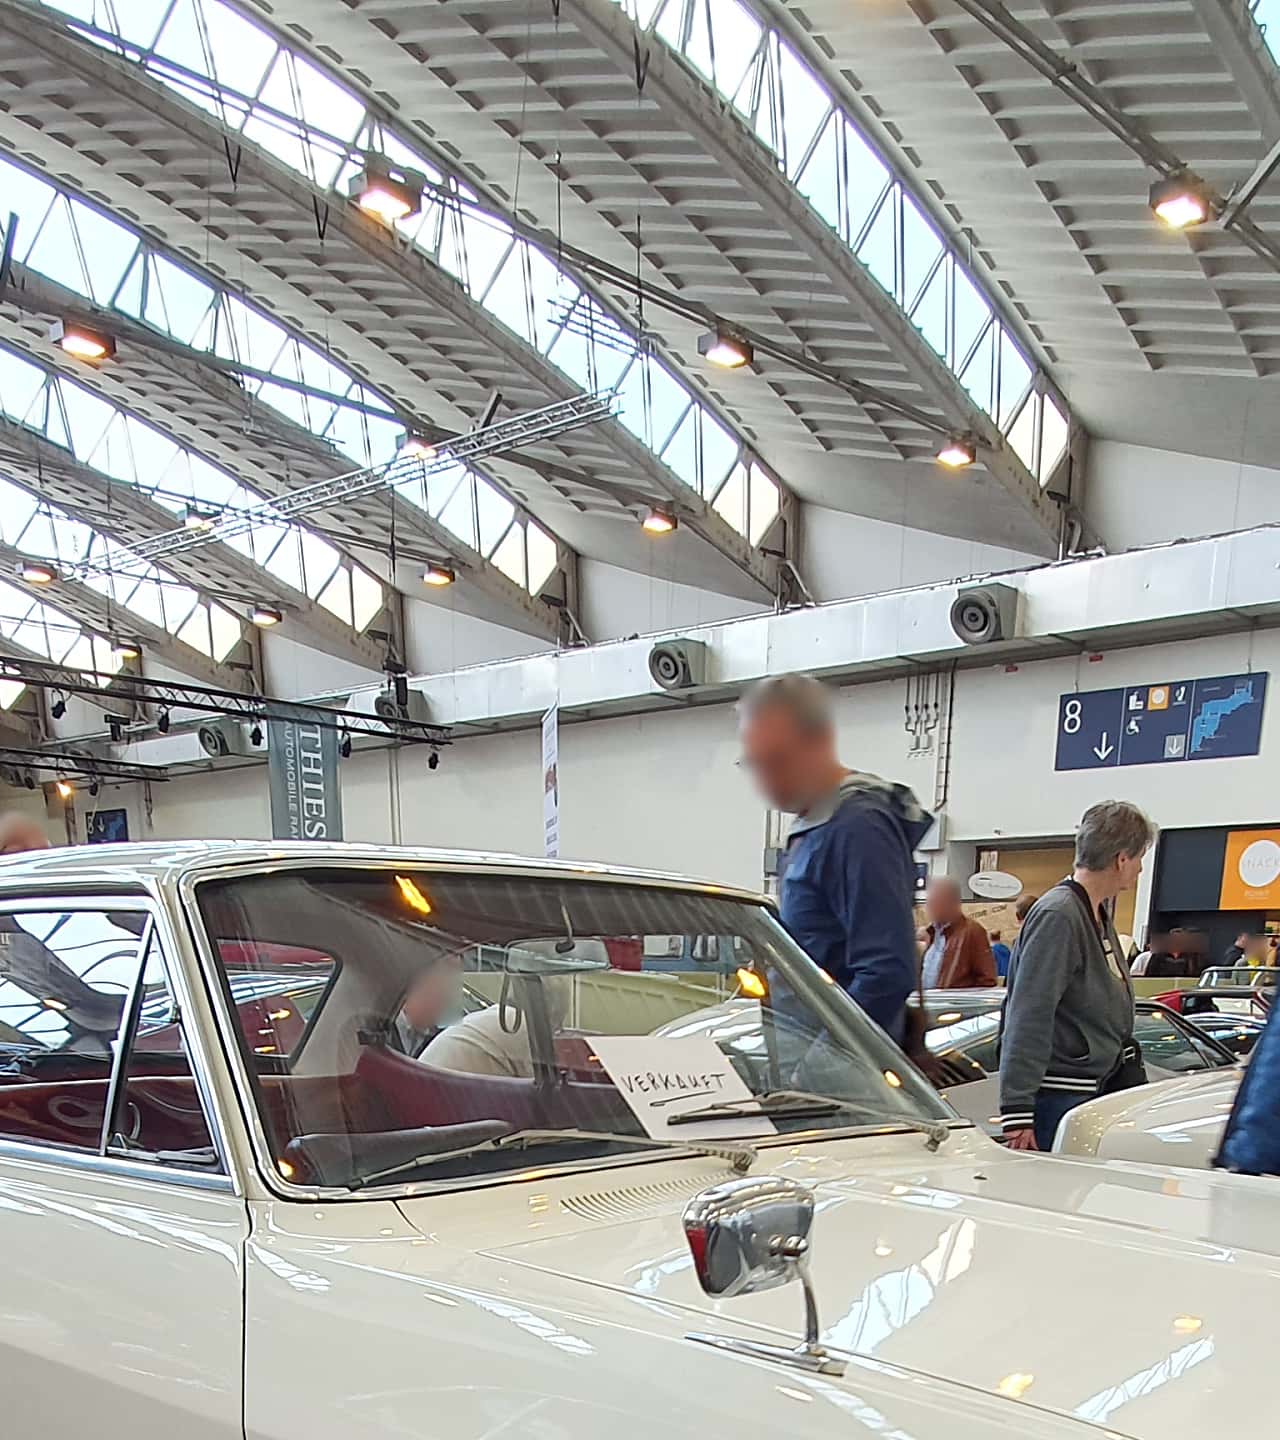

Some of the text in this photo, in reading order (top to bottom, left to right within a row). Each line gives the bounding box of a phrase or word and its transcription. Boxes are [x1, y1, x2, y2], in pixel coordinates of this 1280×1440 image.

[1063, 699, 1082, 734] 8
[299, 724, 327, 838] THIES
[620, 1072, 727, 1094] VERKAUFT
